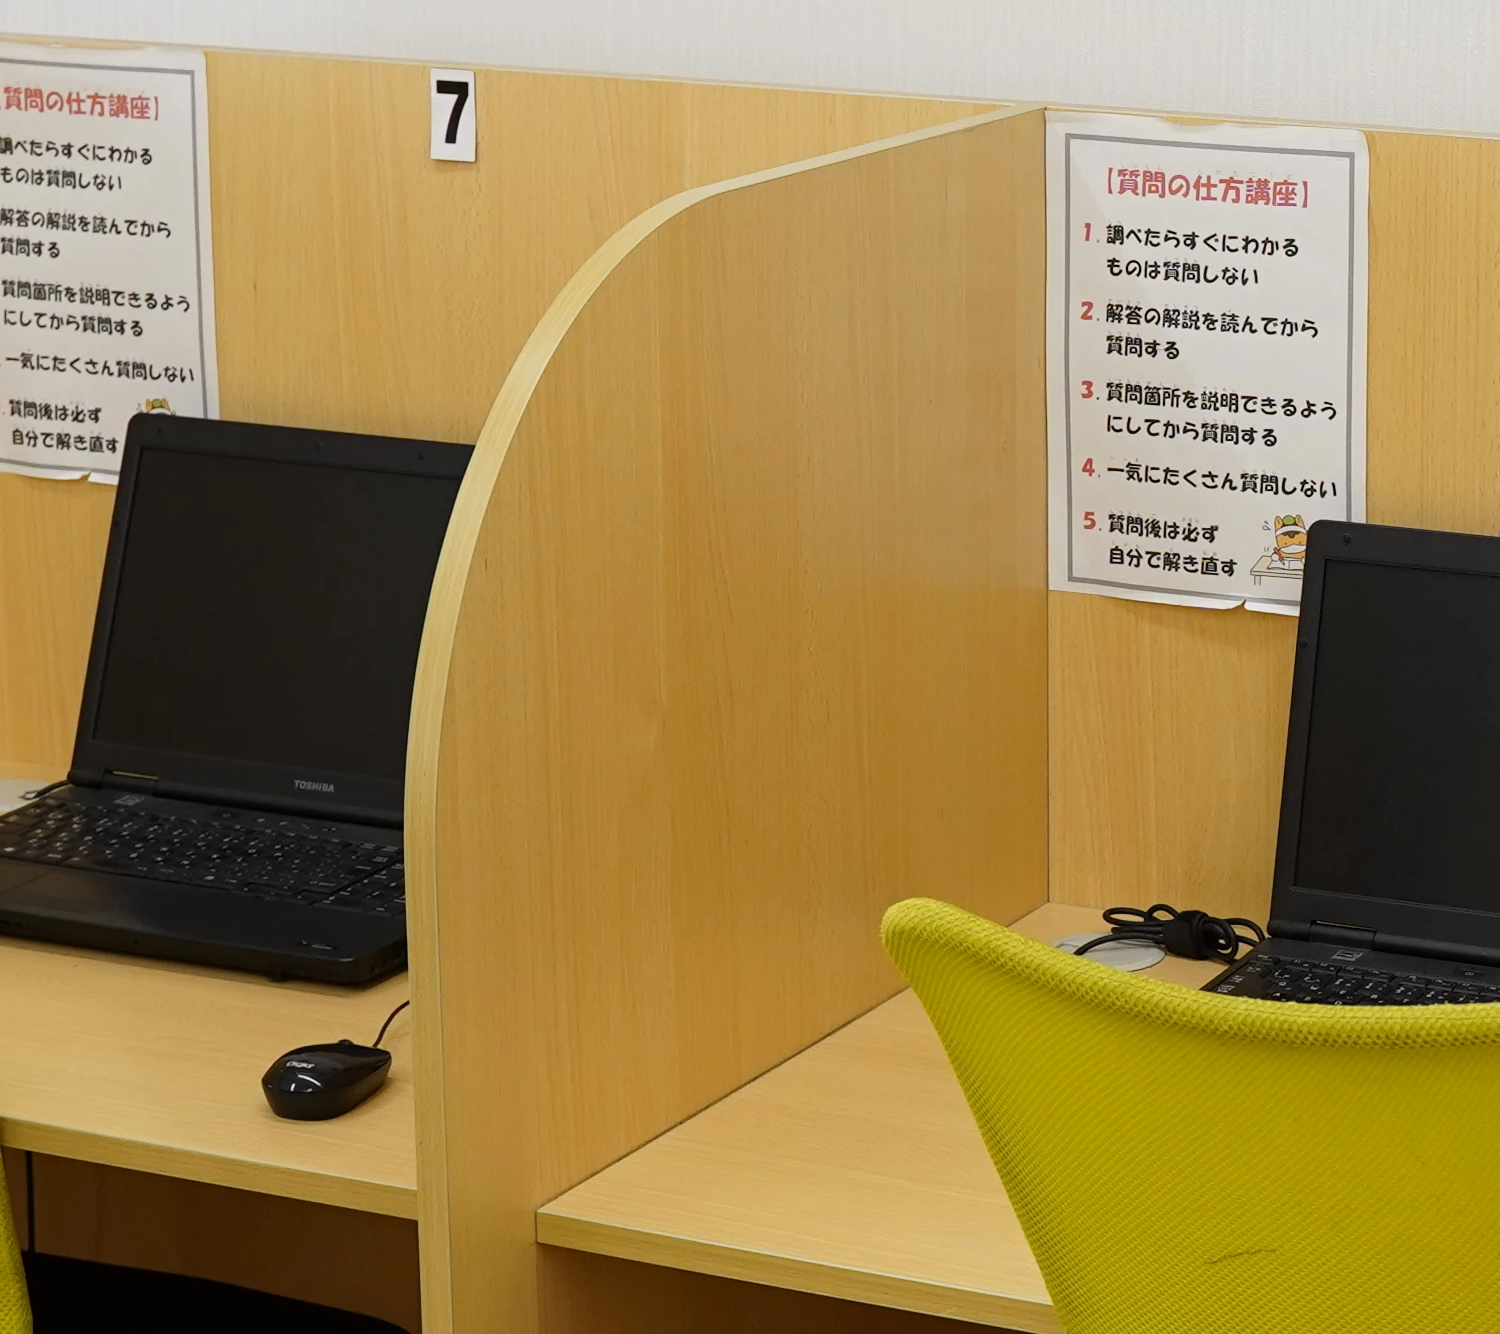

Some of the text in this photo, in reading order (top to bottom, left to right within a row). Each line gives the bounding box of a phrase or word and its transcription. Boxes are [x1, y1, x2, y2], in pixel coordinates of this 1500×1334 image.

[436, 80, 469, 144] 7
[0, 166, 122, 192] ものは質問しない
[0, 208, 172, 238] 解答の解説を読んでから
[0, 237, 61, 258] 質問する
[1084, 222, 1299, 257] 1. 調べたらすぐにわかる
[1106, 257, 1259, 286] ものは質問しない
[1, 279, 191, 313] 質問箇所を説明できるよう
[3, 309, 144, 337] にしてから質問する
[1080, 301, 1319, 338] 2. 解答の解説を読んでから
[1106, 335, 1180, 360] 質問する
[5, 352, 194, 383] 一気にたくさん質問しない
[8, 399, 102, 423] 質問後は必ず
[1080, 381, 1337, 420] 3. 質問箇所を説明できるよう
[12, 429, 119, 454] 自分で解き直す
[1106, 415, 1278, 447] にしてから質問する
[1081, 458, 1337, 499] 4. 一気にたくさん質問しない
[1083, 511, 1219, 543] 5. 質問後は必ず
[1109, 546, 1237, 577] 自分で解き直す
[294, 779, 335, 793] TOSHIBA
